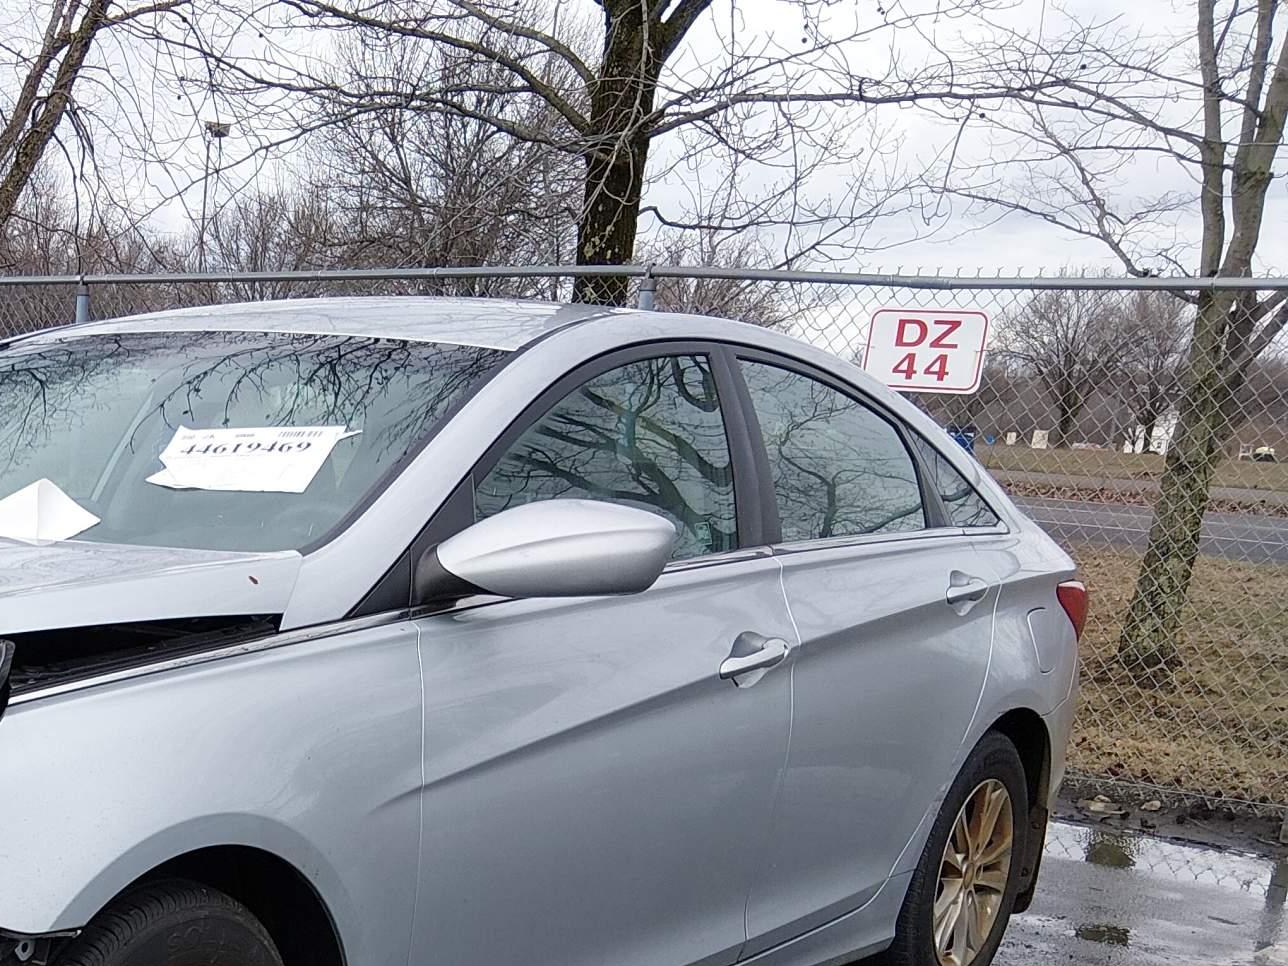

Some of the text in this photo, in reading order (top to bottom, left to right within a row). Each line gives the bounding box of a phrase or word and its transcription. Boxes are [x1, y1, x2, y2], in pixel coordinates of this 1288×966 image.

[895, 318, 963, 349] DZ
[891, 352, 950, 382] 44
[180, 439, 313, 456] 44619469
